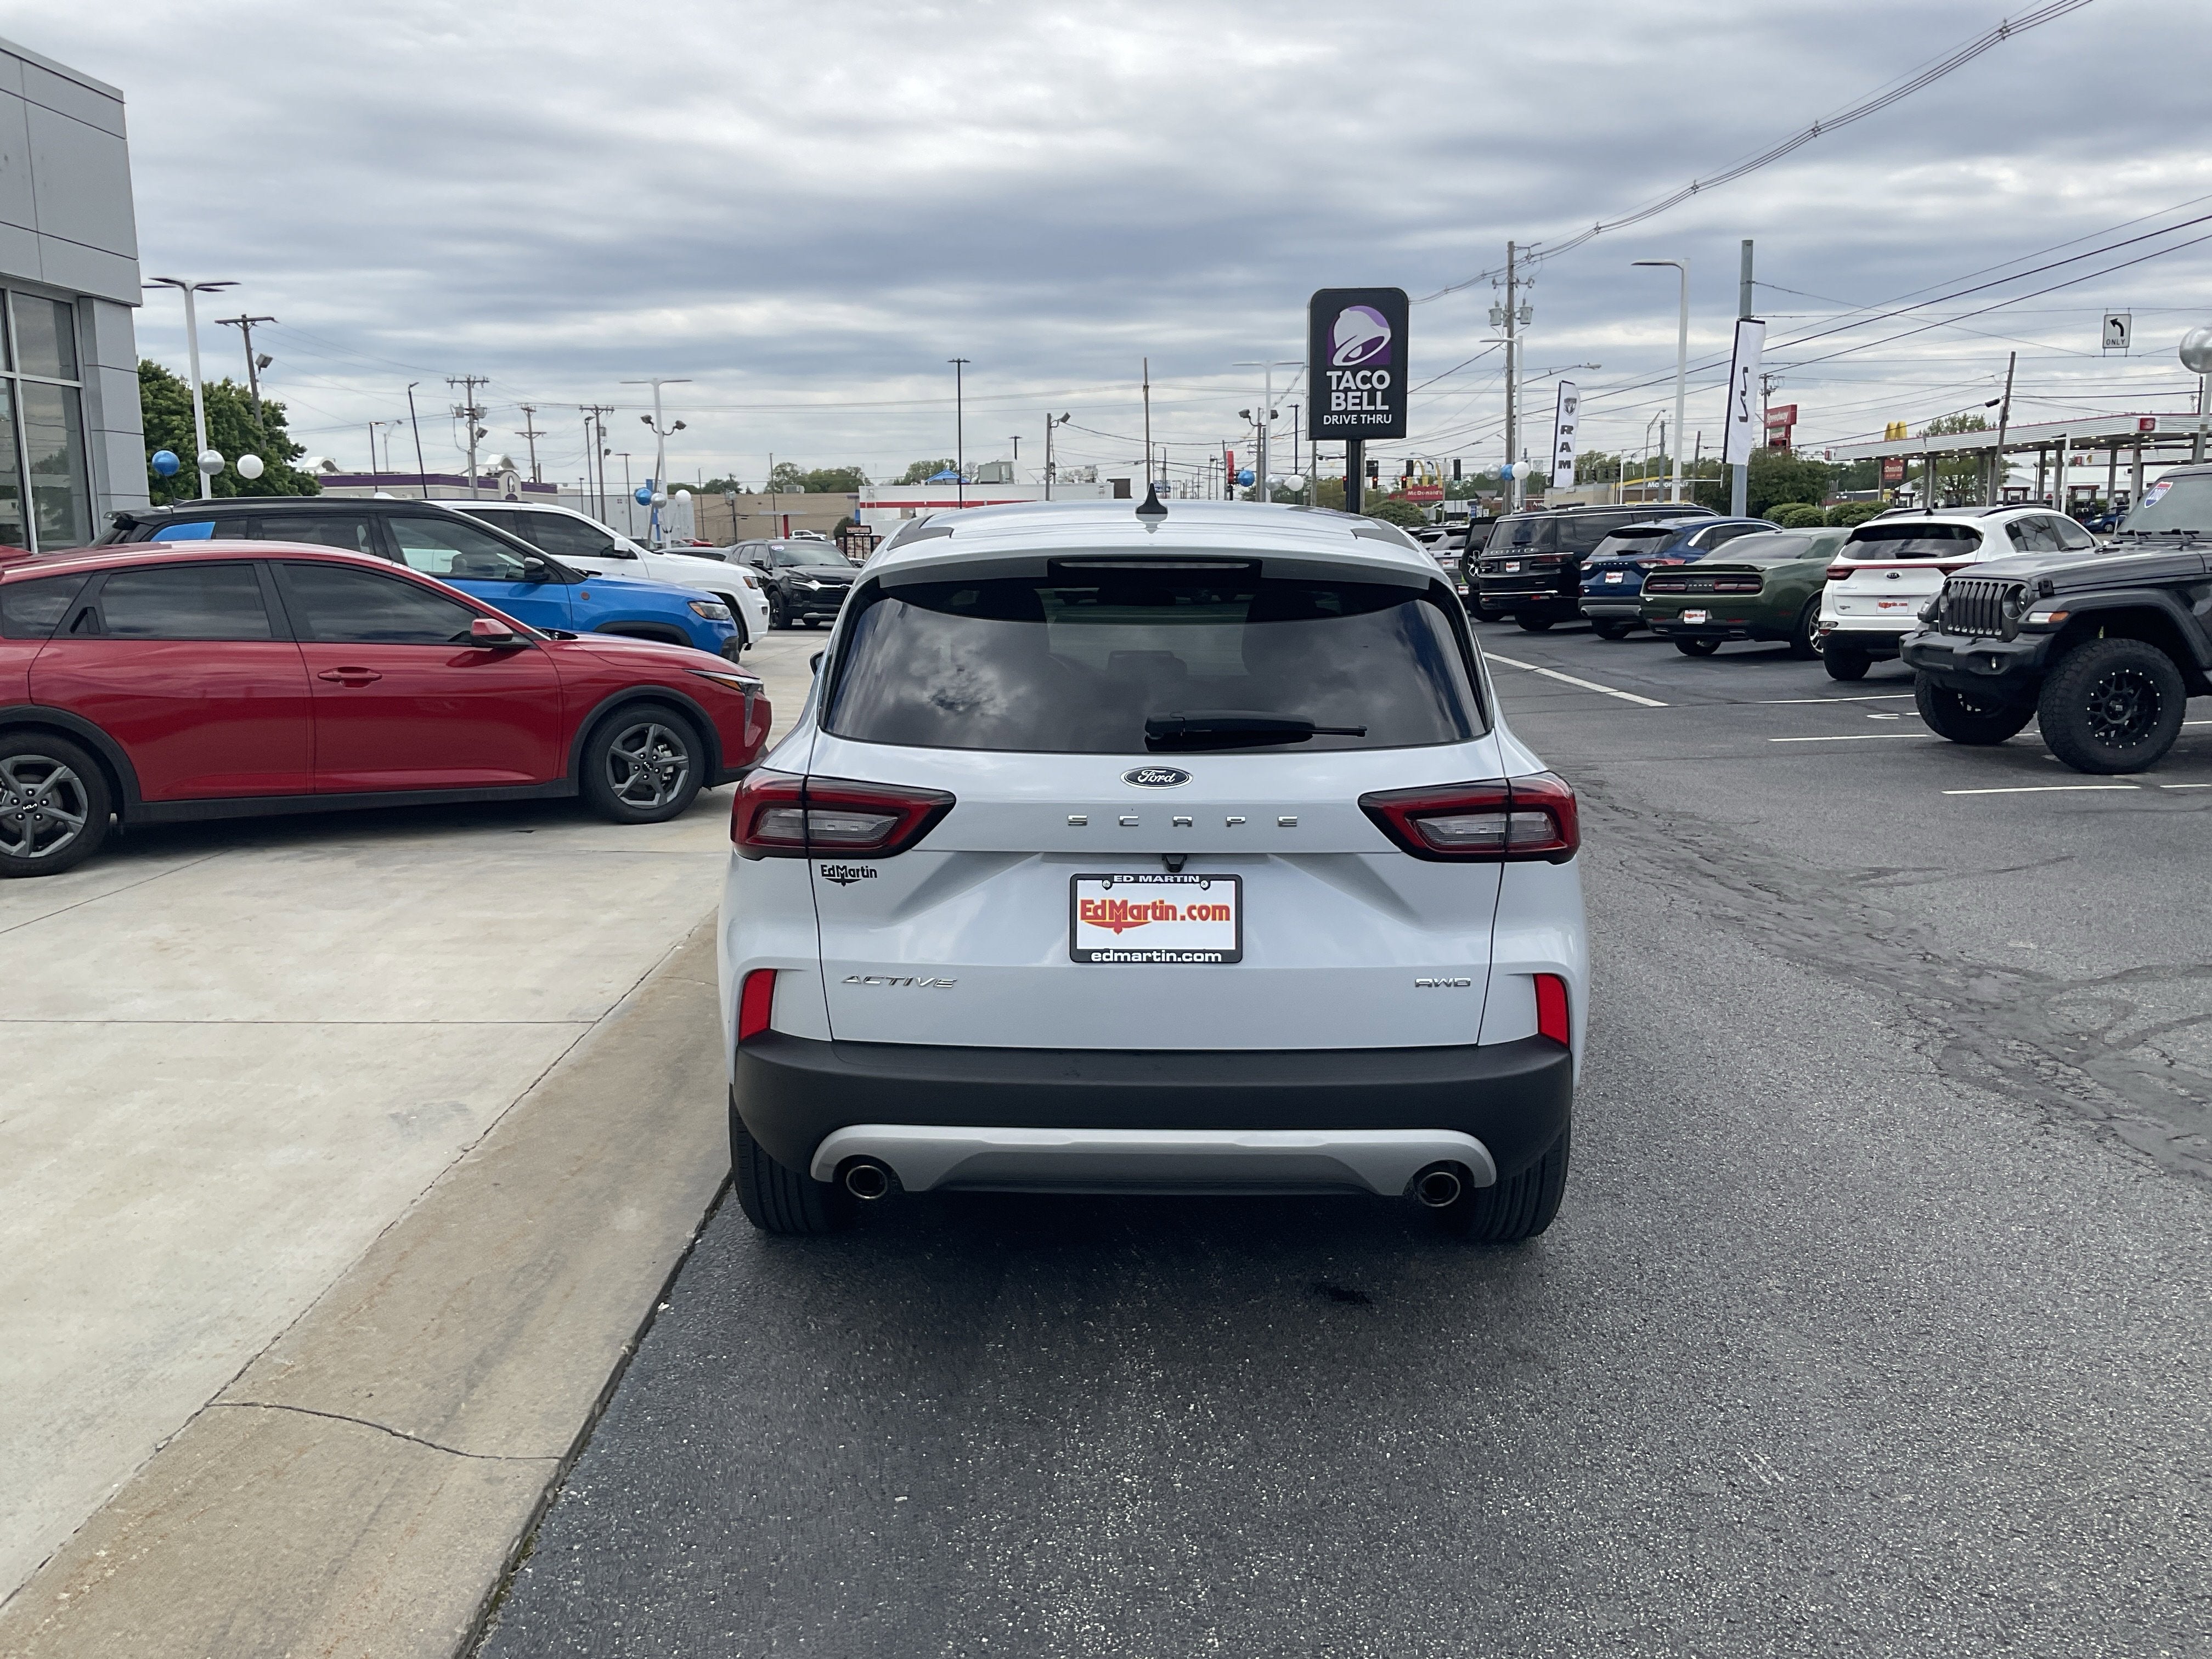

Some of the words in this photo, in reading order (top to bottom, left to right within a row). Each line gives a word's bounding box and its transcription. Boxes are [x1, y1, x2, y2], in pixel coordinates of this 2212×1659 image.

[1326, 370, 1390, 390] TACO
[1331, 391, 1389, 411] BELL
[1323, 415, 1357, 425] DRIVE
[1360, 414, 1392, 425] THRU
[1558, 425, 1573, 469] RAM
[1137, 769, 1176, 784] Ford
[1080, 899, 1231, 923] EdMartin.com
[1091, 950, 1222, 962] edmartin.com
[840, 974, 957, 988] ACTIVE
[1415, 978, 1471, 987] AWD
